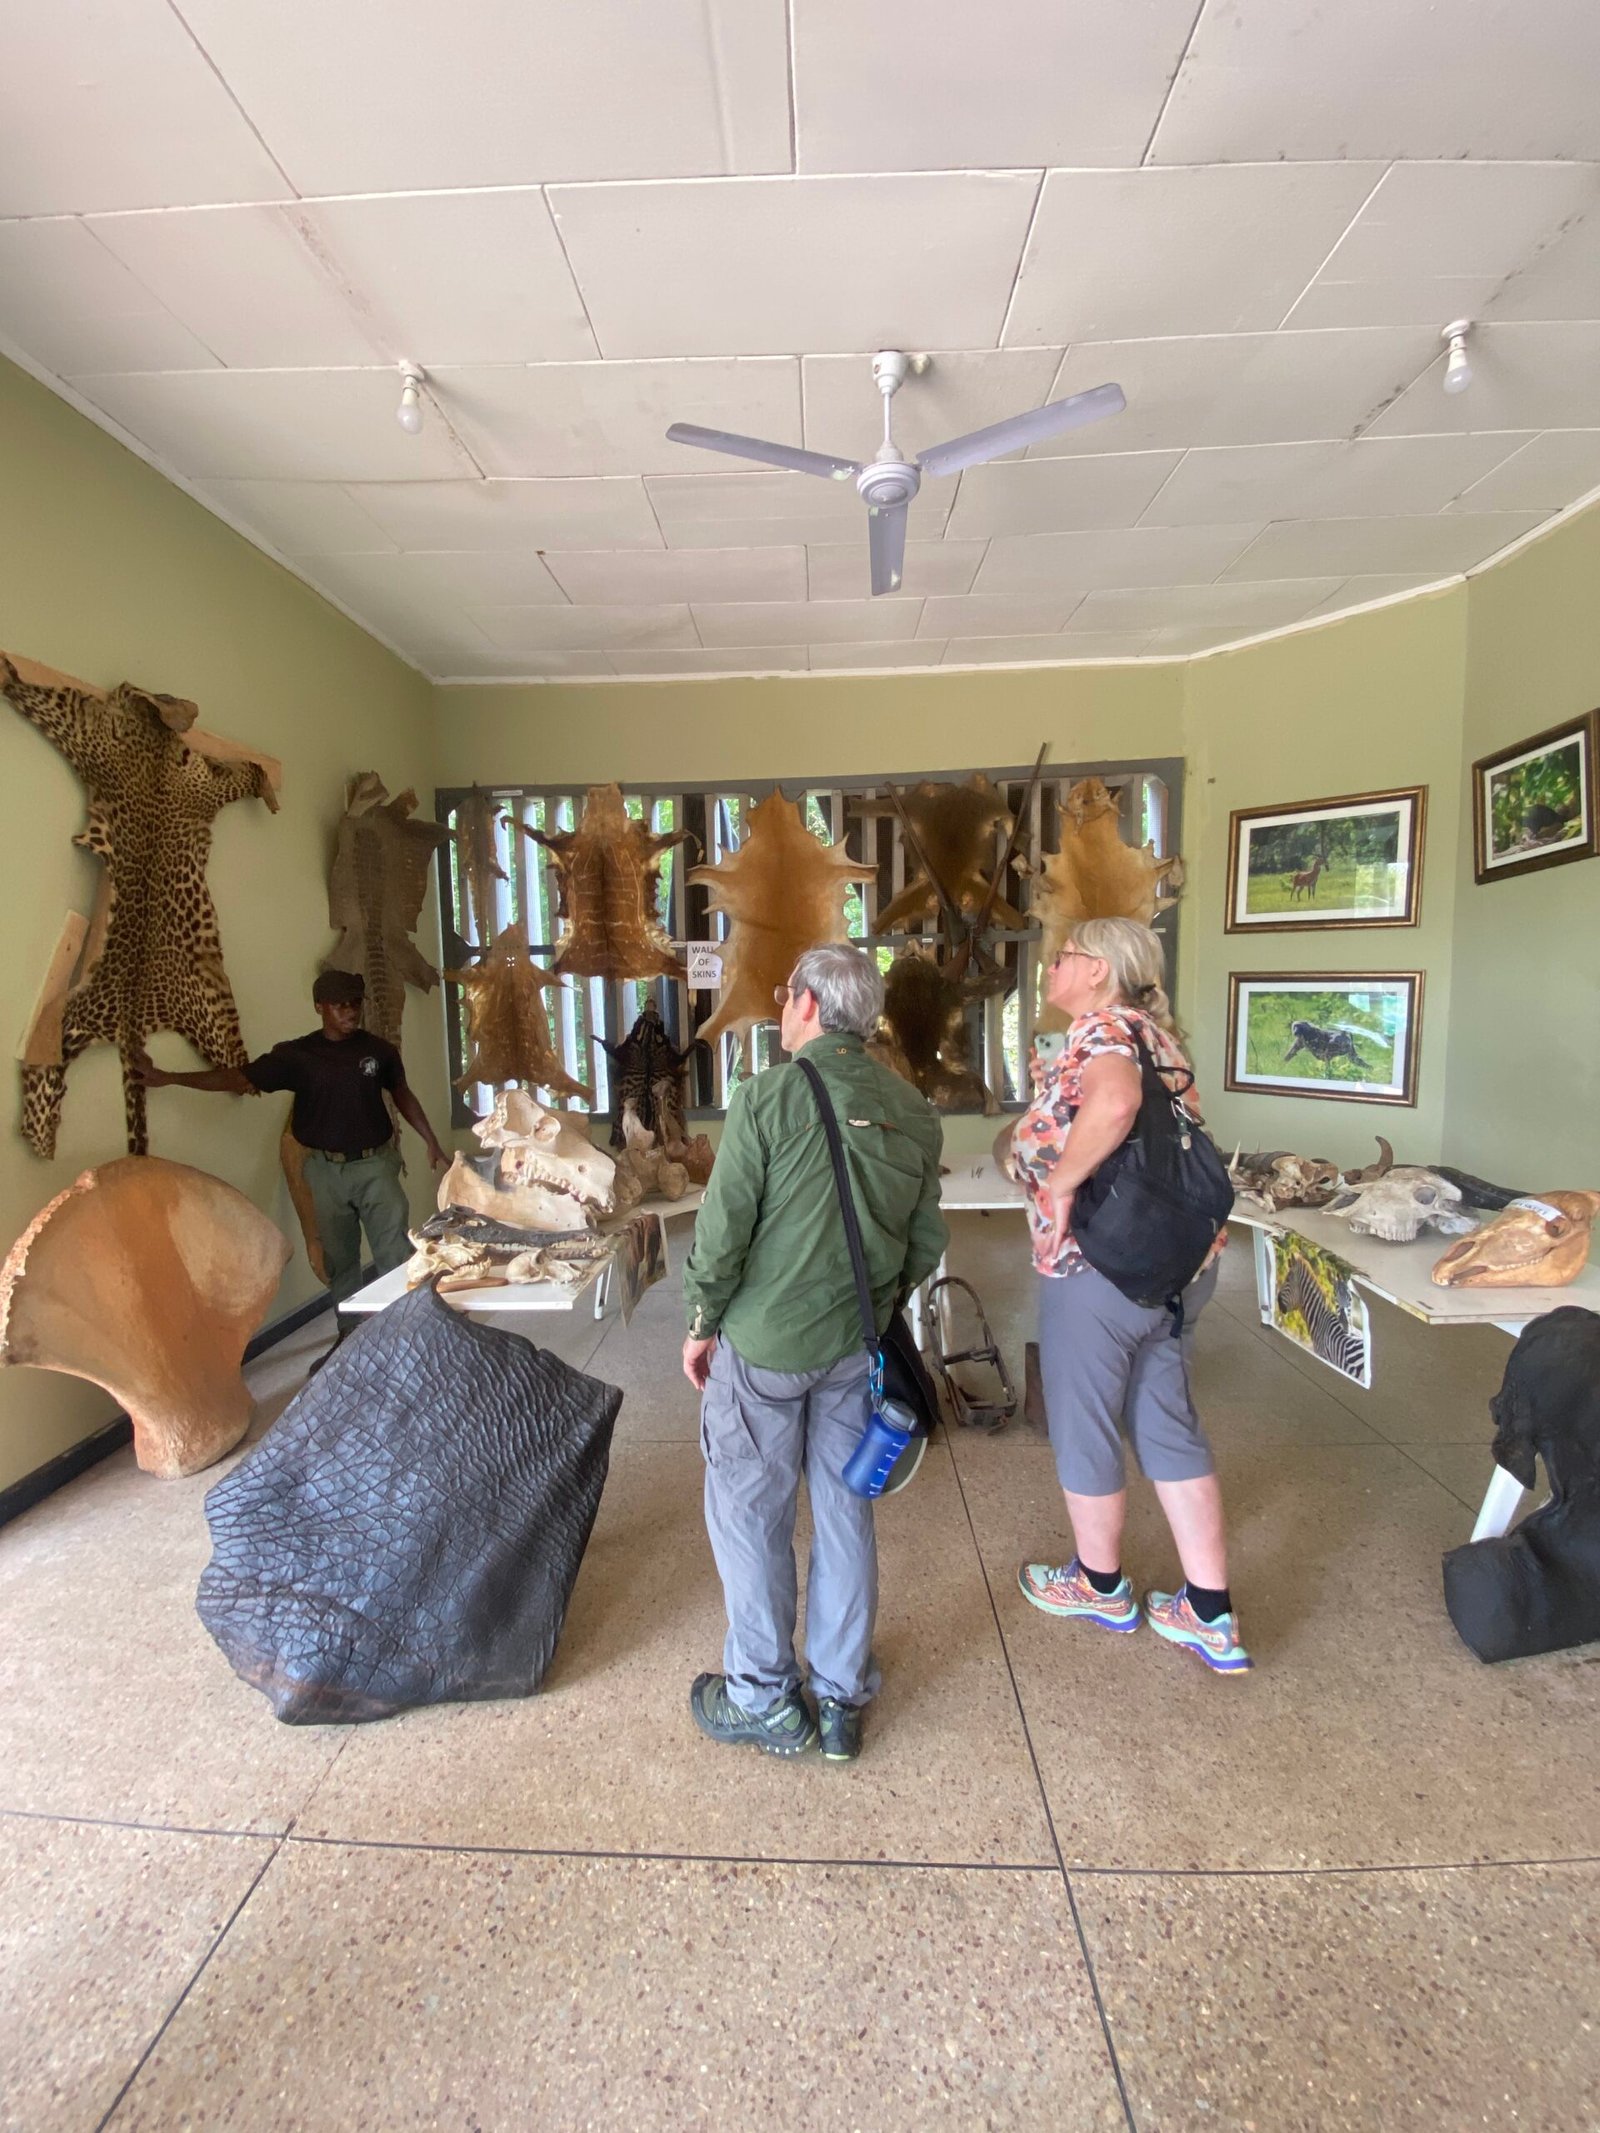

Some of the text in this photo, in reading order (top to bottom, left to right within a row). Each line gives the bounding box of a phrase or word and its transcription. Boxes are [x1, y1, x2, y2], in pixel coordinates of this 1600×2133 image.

[691, 946, 714, 954] WALL
[698, 958, 710, 966] OF
[692, 970, 717, 978] SKINS
